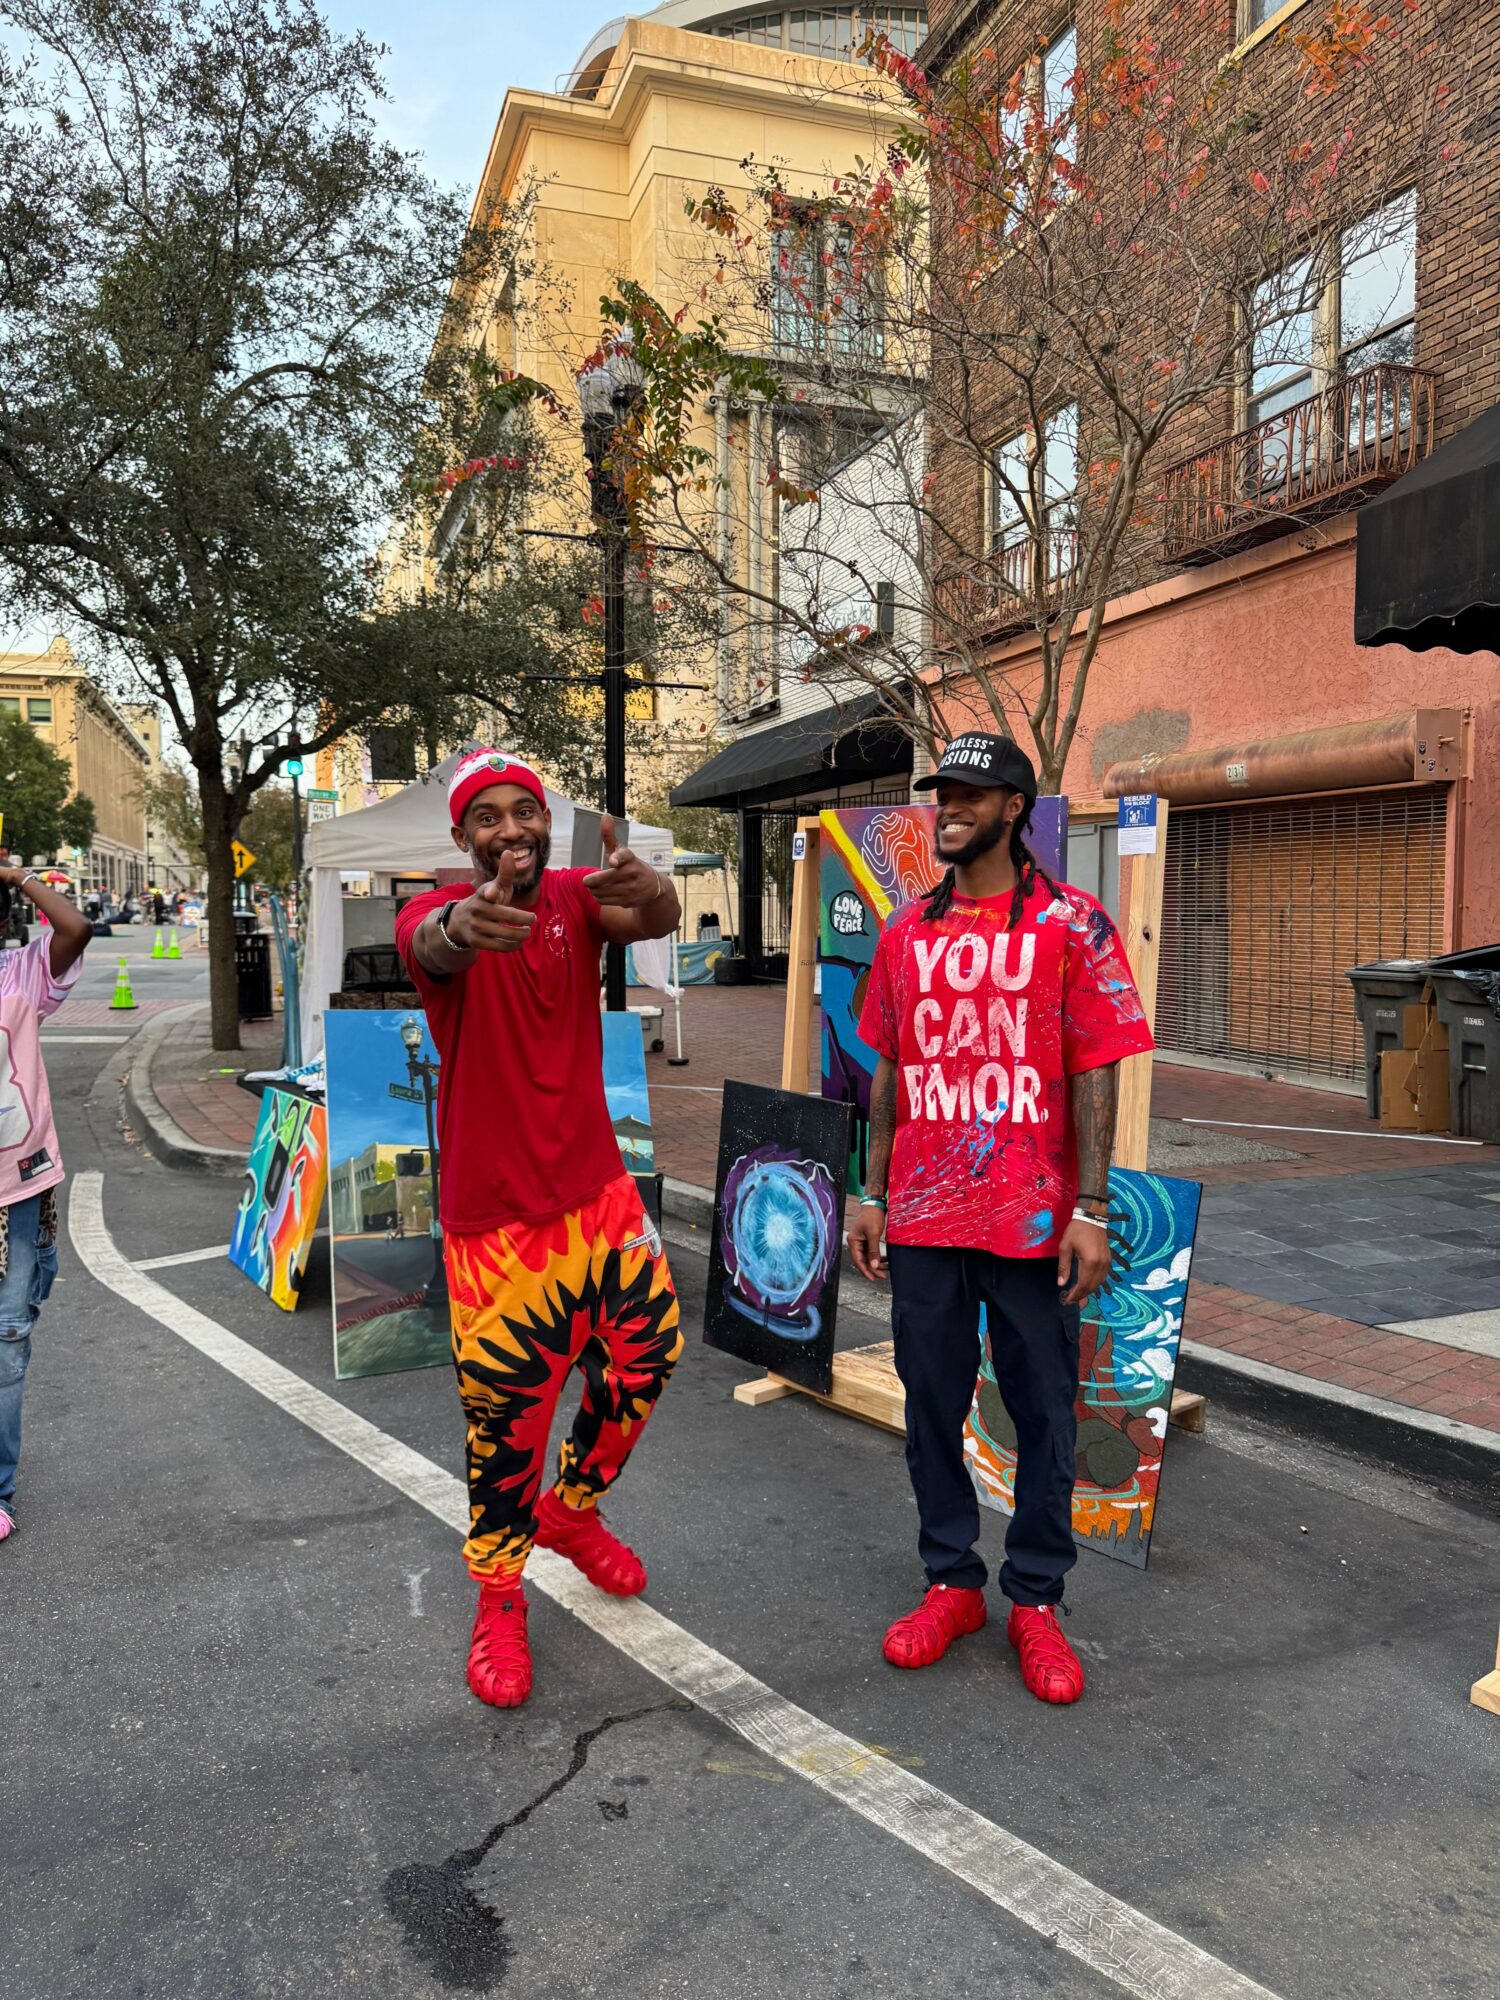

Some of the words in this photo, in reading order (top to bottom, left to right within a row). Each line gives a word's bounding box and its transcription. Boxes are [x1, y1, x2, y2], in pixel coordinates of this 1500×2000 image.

[1227, 765, 1244, 778] 237
[834, 896, 863, 919] LOVE
[833, 914, 863, 933] PEACE
[912, 932, 1037, 993] YOU
[913, 996, 1029, 1059] CAN
